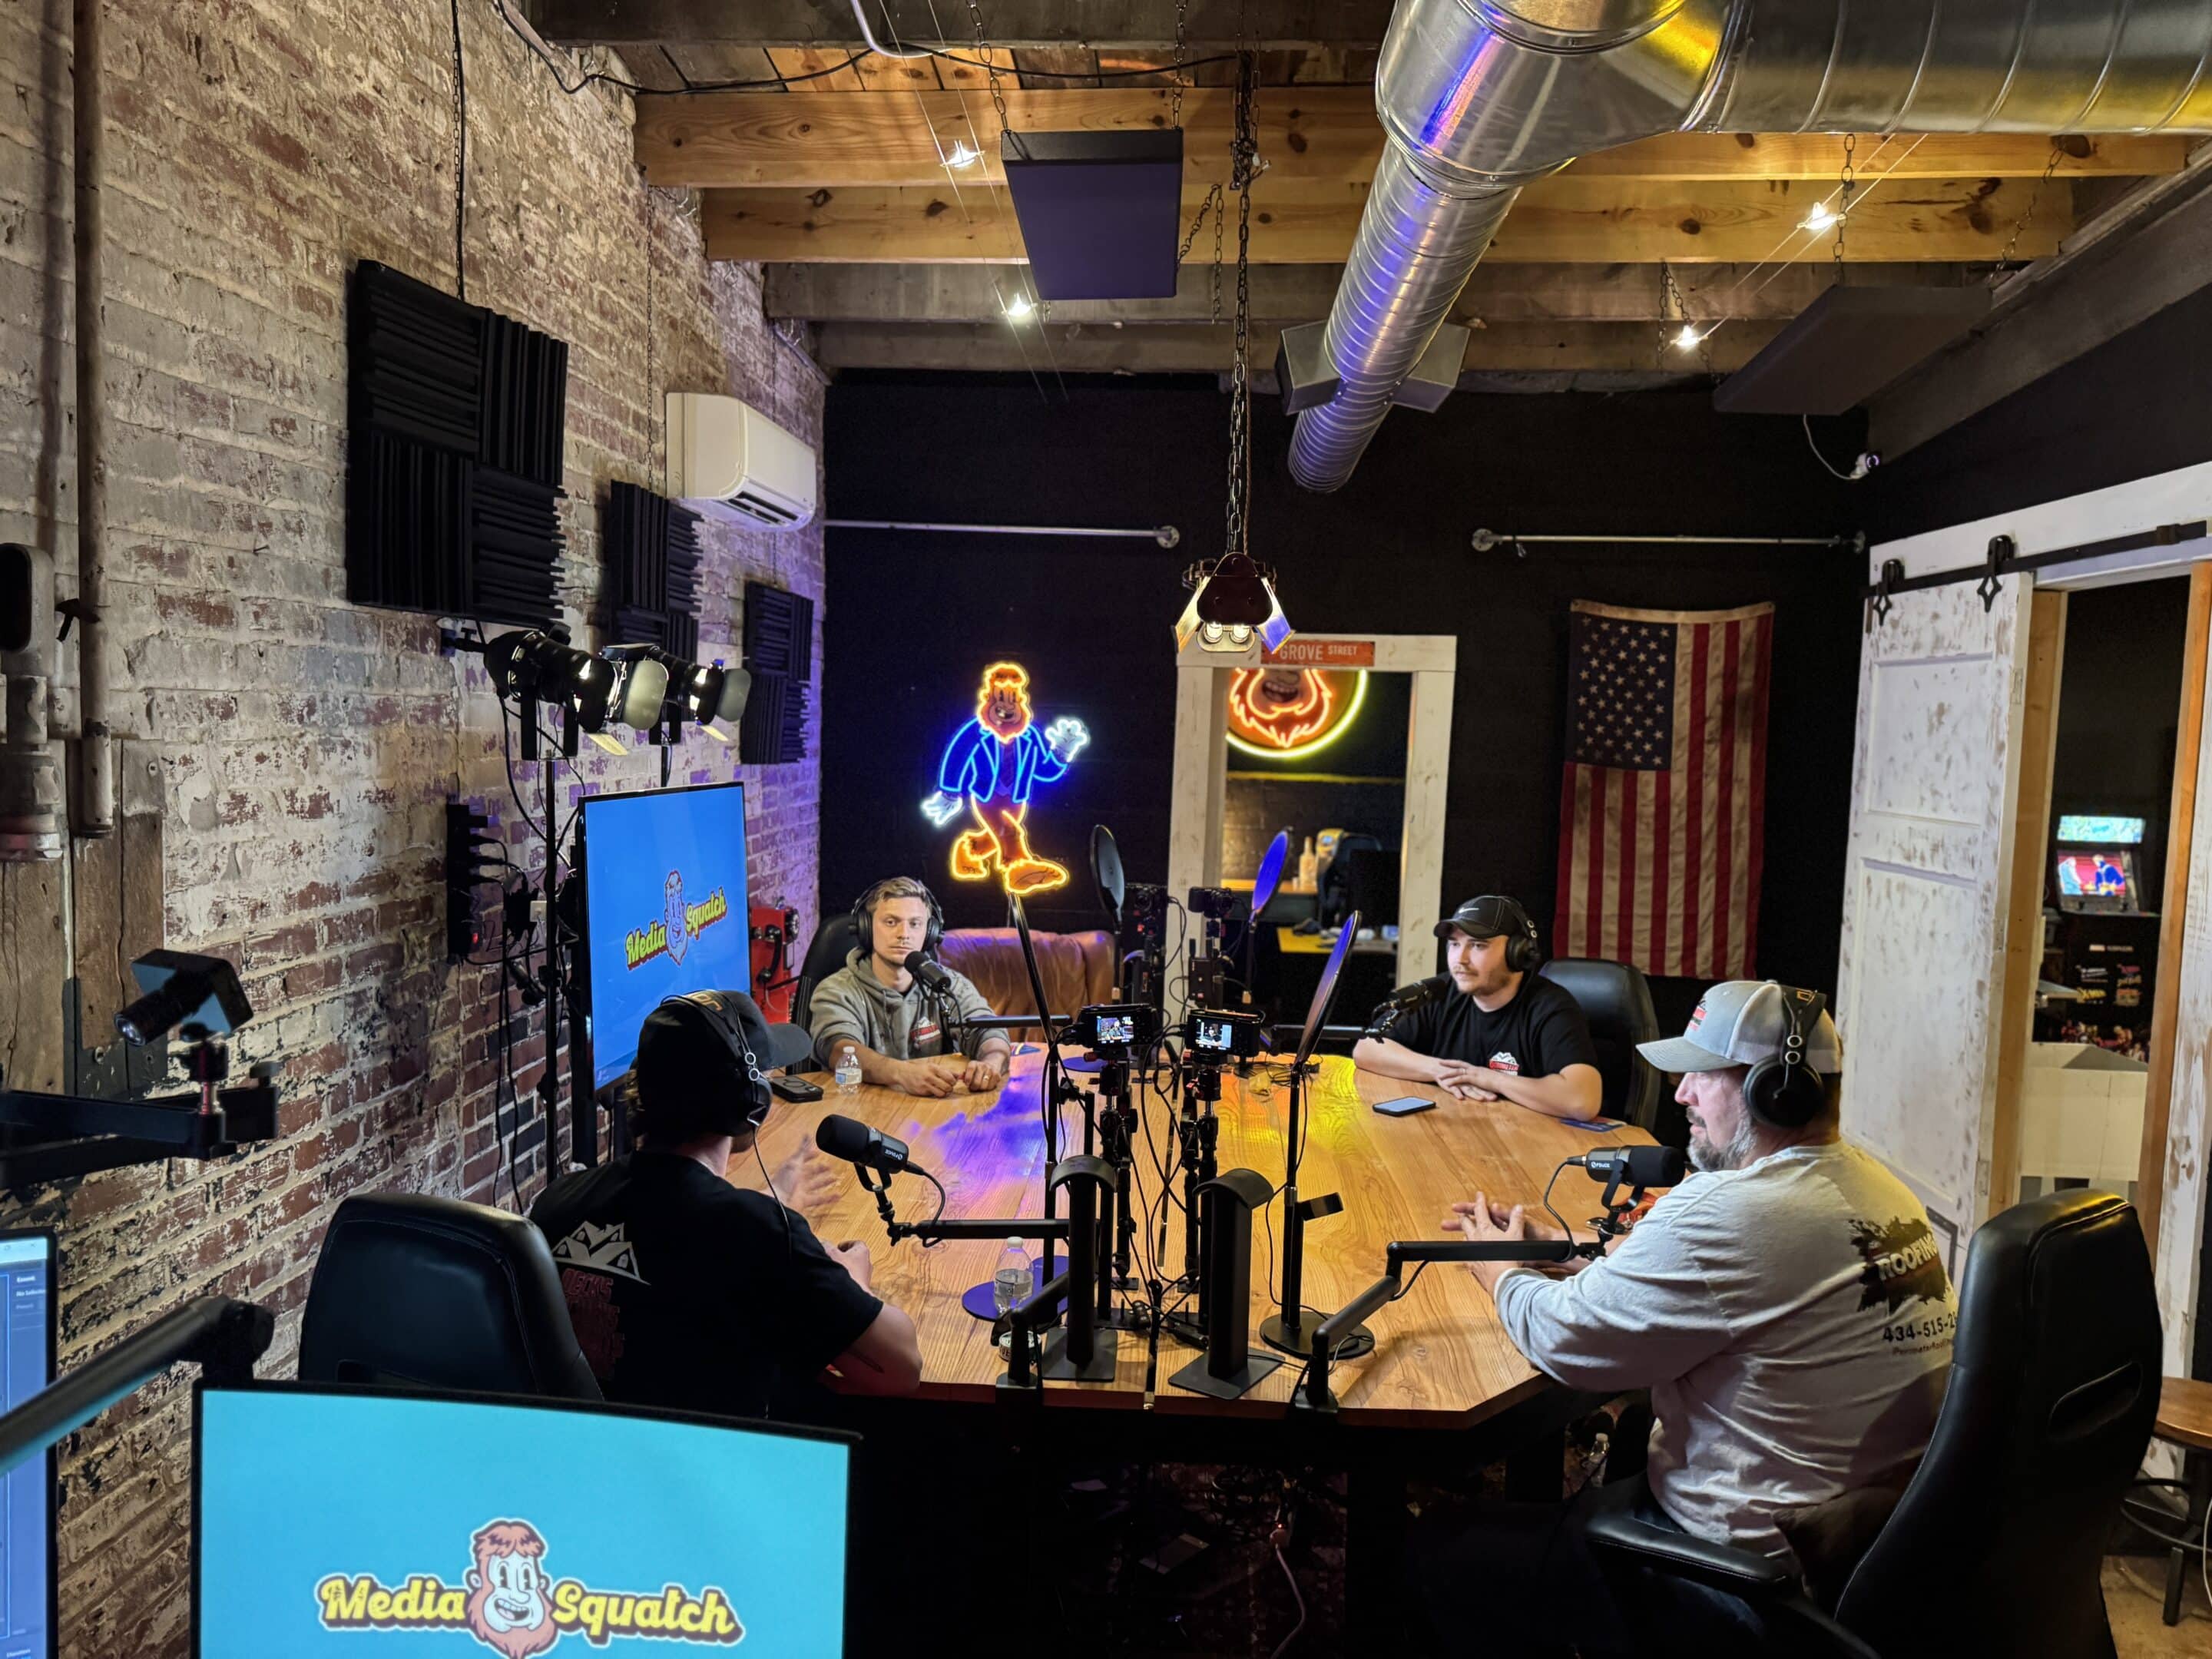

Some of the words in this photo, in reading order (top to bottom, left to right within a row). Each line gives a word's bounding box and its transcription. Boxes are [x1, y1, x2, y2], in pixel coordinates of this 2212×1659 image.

[1280, 644, 1324, 661] GROVE
[1327, 644, 1358, 656] STREET
[624, 920, 667, 969] Media
[686, 886, 727, 939] Squatch
[1874, 1233, 1938, 1281] ROOFIN
[318, 1577, 468, 1624] Media
[551, 1582, 739, 1639] Squatch
